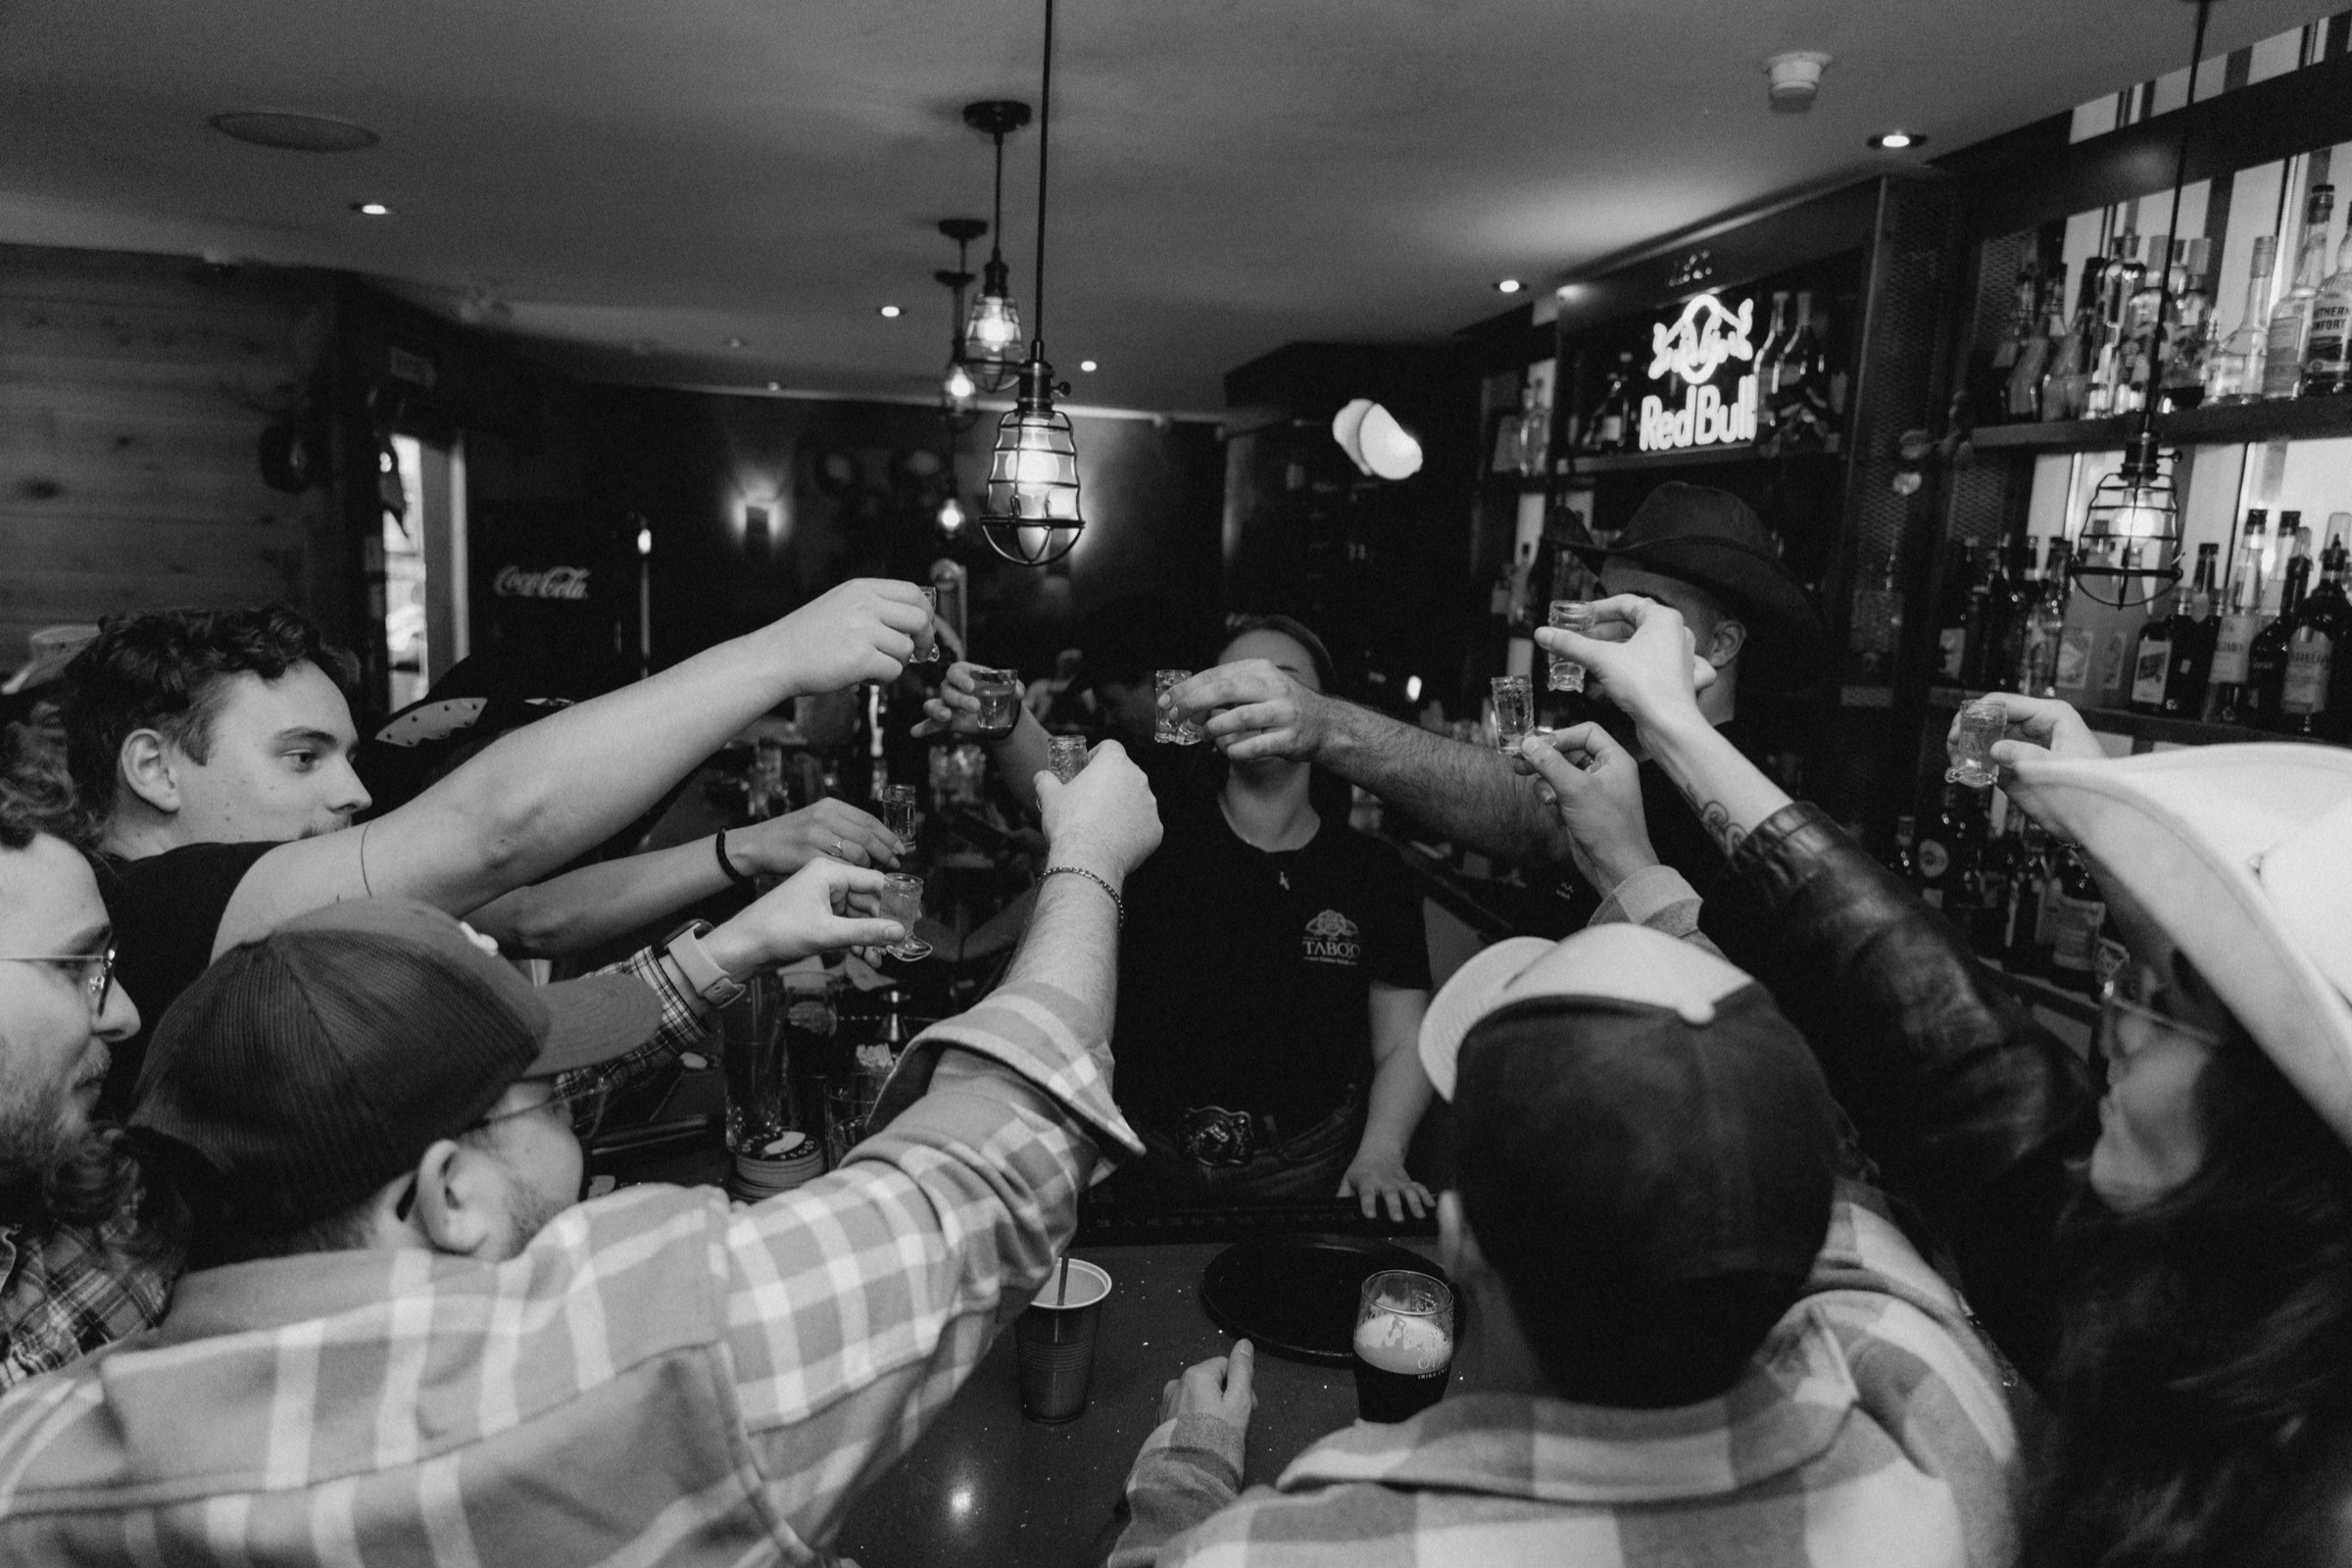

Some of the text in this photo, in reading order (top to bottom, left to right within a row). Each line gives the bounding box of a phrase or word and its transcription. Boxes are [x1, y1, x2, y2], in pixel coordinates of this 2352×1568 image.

[1640, 373, 1757, 452] Red Bull
[1302, 941, 1360, 958] TABOO
